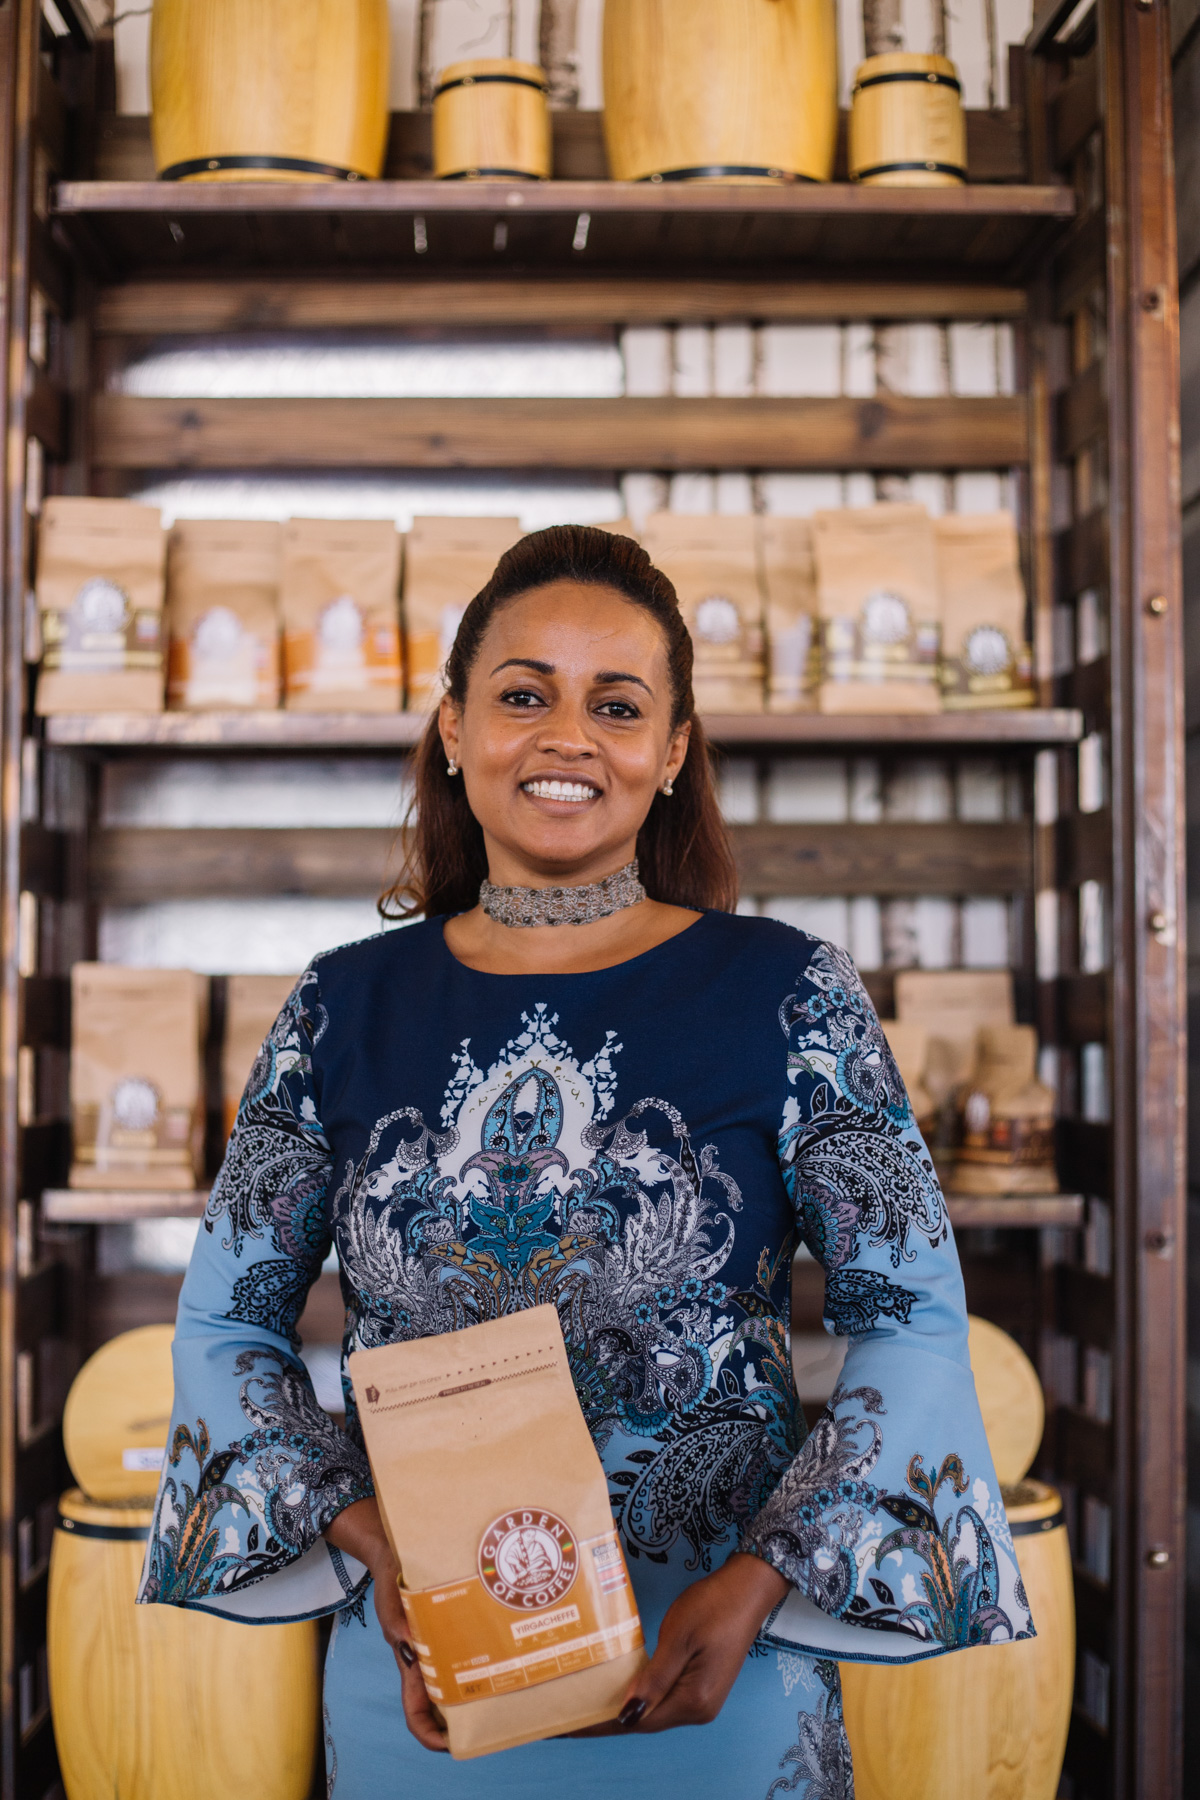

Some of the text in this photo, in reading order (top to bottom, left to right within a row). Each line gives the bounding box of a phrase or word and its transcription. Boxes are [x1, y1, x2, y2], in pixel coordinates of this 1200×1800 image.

[483, 1512, 565, 1559] GARDEN
[493, 1581, 516, 1601] OF
[522, 1561, 575, 1607] COFFEE
[515, 1609, 576, 1635] YIRGACHEFFE
